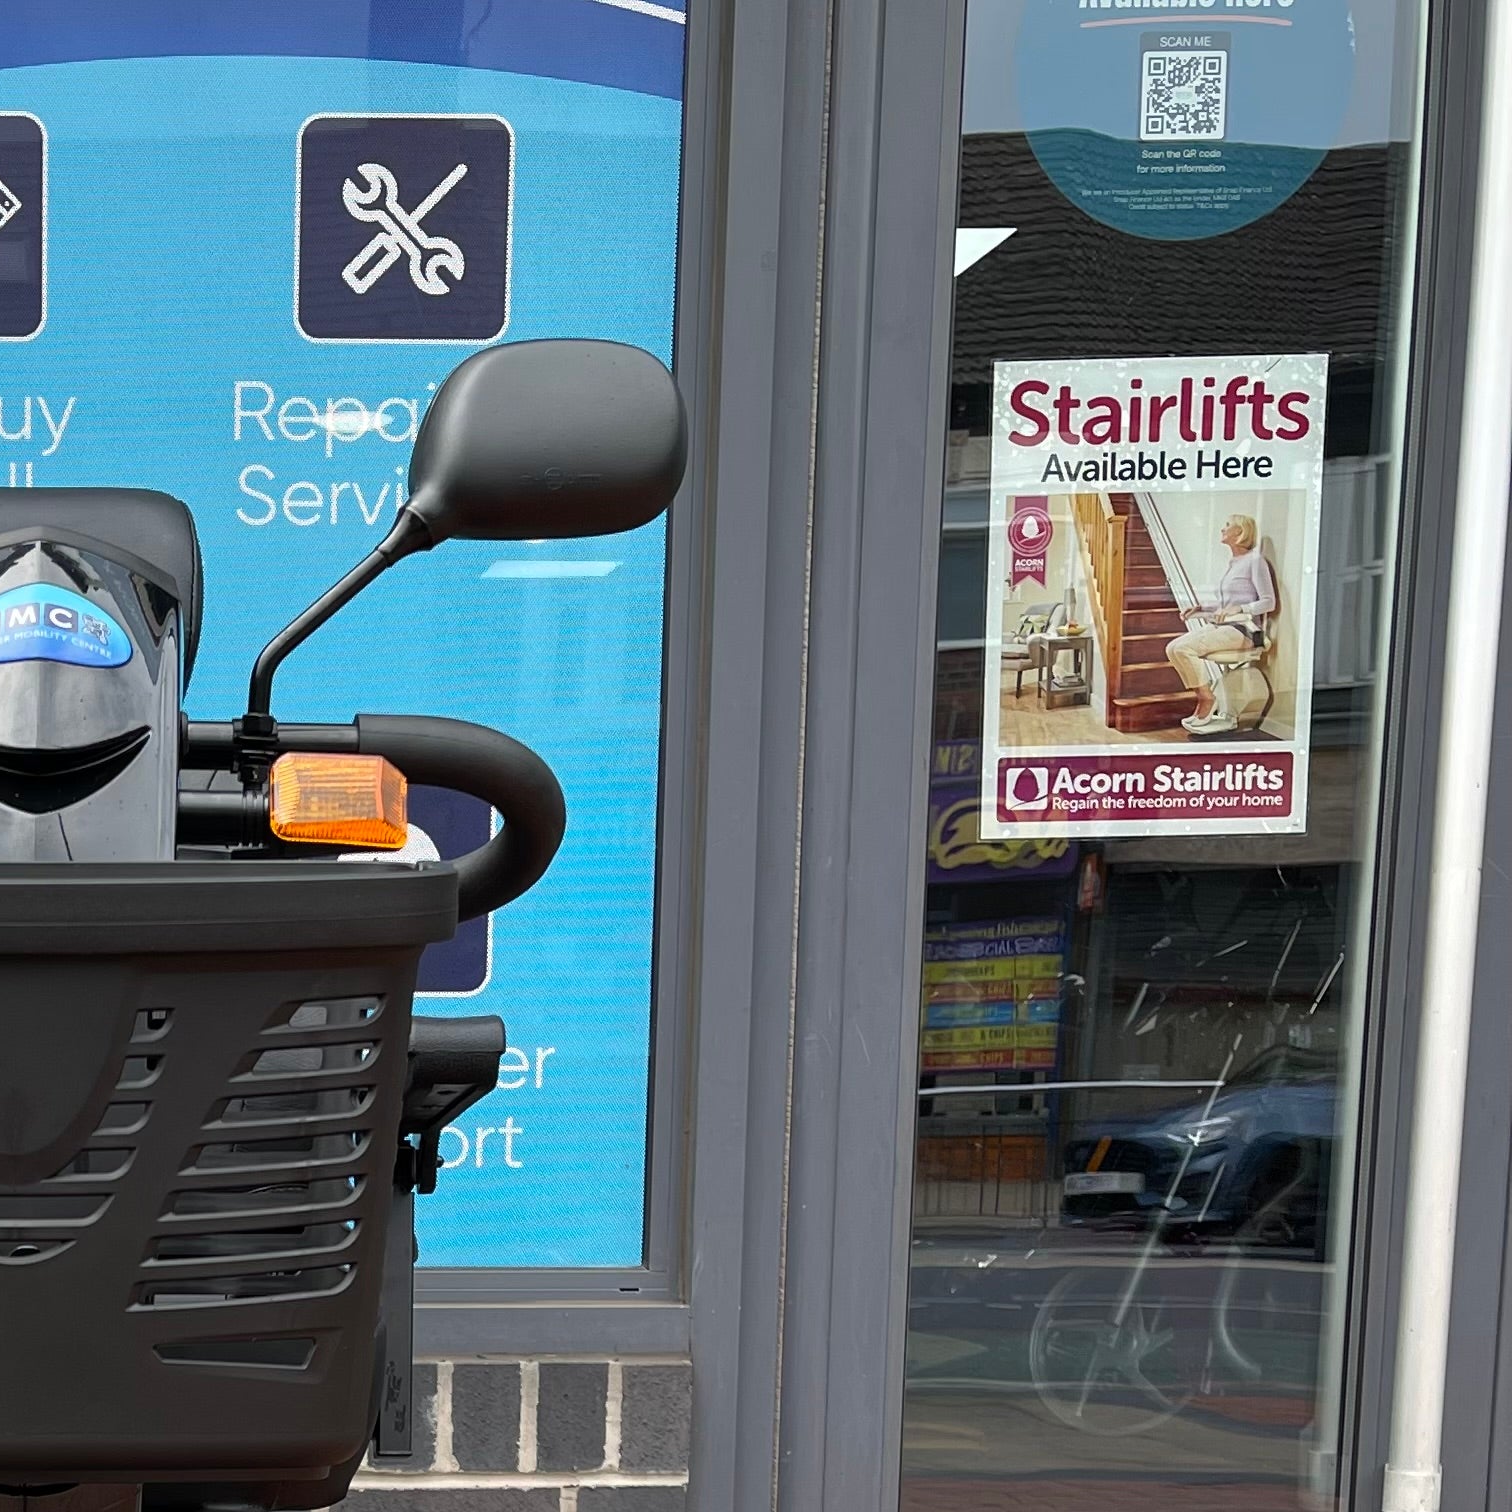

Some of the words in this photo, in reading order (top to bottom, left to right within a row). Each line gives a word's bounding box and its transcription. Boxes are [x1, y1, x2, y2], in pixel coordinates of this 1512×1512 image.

[1160, 36, 1191, 47] SCAN
[1194, 36, 1212, 47] ME
[1141, 149, 1164, 158] Scan
[1166, 150, 1181, 158] the
[1183, 149, 1197, 158] QR
[1198, 150, 1222, 158] code
[1136, 164, 1149, 173] for
[1150, 165, 1174, 173] more
[1175, 164, 1226, 173] information
[233, 381, 437, 457] Repa
[1008, 376, 1310, 447] Stairlifts
[1041, 451, 1187, 482] Available
[1196, 450, 1273, 478] Here
[236, 464, 405, 526] Servi
[1015, 559, 1044, 567] ACORN
[13, 630, 67, 643] MOBILITY
[1052, 767, 1145, 794] Acorn
[1153, 763, 1284, 792] Stairlifts
[1052, 796, 1099, 813] Regain
[1102, 795, 1125, 809] the
[1128, 795, 1187, 809] freedom
[1189, 794, 1205, 807] of
[1206, 796, 1238, 810] your
[1242, 793, 1283, 806] home
